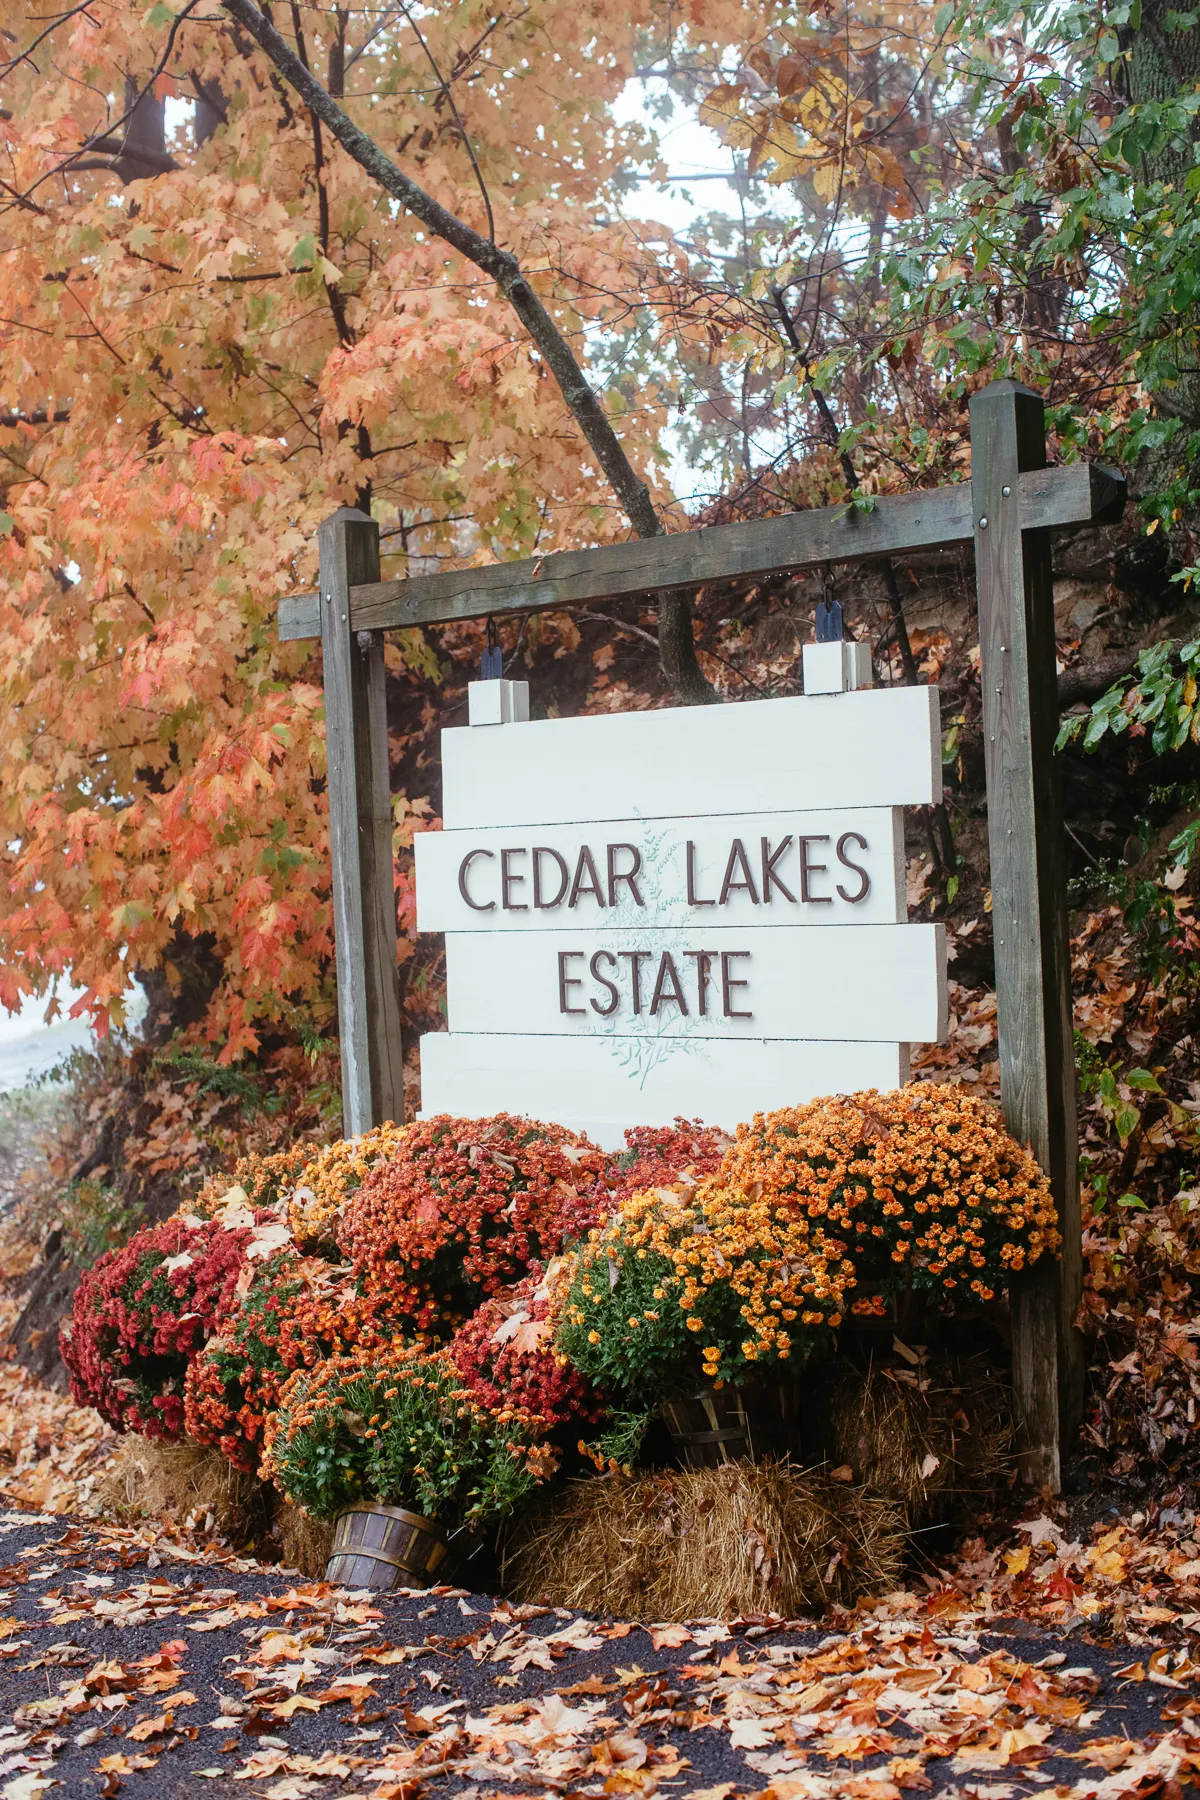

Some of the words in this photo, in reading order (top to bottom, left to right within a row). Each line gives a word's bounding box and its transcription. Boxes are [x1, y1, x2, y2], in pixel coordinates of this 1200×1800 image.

[458, 843, 645, 911] CEDAR
[686, 831, 871, 907] LAKES
[557, 949, 753, 1019] ESTATE
